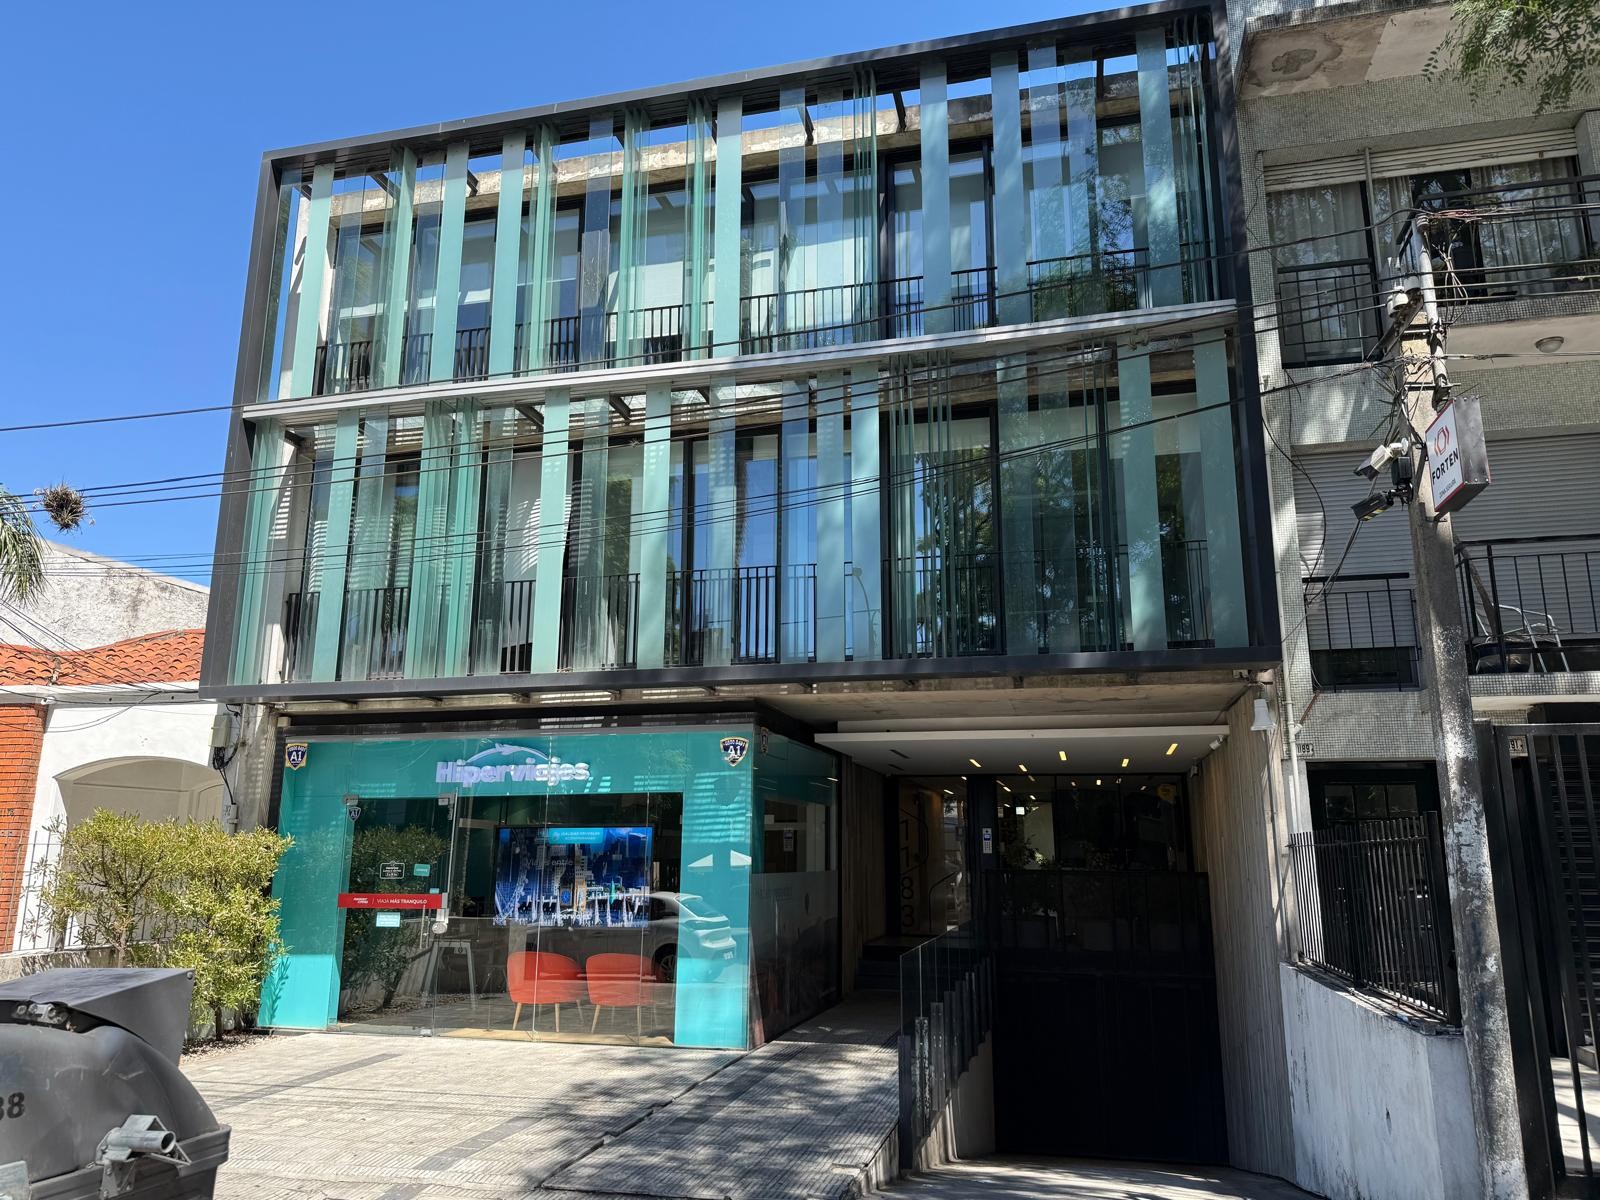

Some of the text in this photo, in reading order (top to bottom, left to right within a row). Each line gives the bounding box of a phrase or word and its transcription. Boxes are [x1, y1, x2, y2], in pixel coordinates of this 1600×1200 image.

[1432, 447, 1459, 485] FORTEN
[290, 751, 302, 761] A1
[436, 756, 590, 788] Hiperviajes
[0, 1091, 25, 1120] 8
